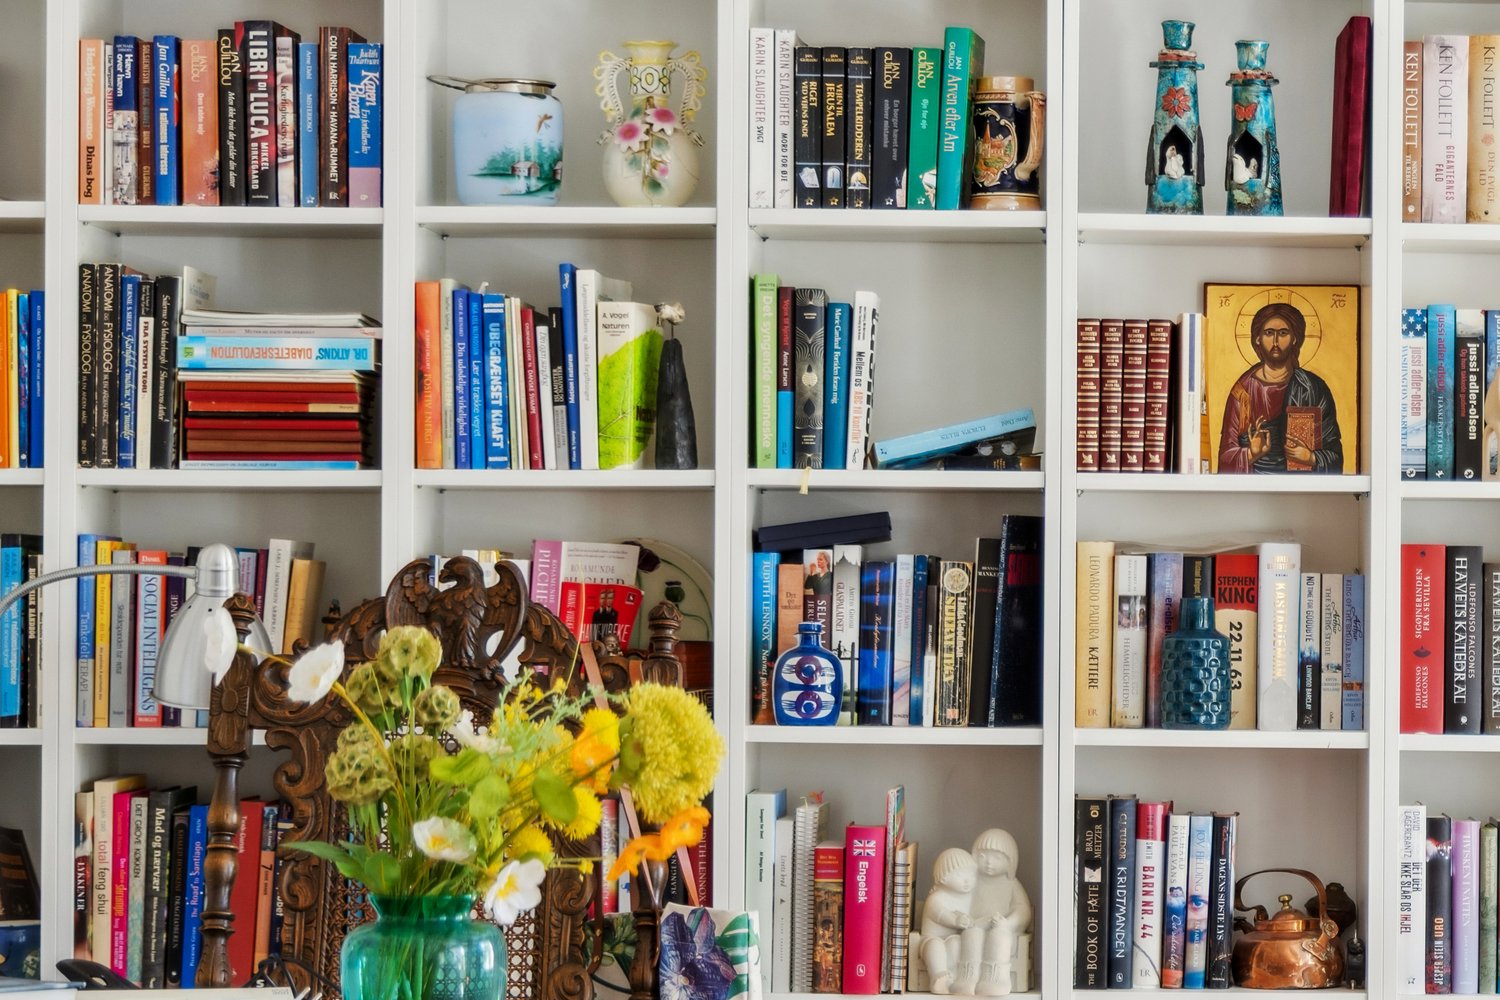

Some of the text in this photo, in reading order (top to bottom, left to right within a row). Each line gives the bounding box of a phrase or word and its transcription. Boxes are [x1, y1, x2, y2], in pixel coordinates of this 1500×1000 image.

[780, 40, 789, 69] KARIN
[249, 31, 268, 138] LIBRI DI LUCA
[329, 36, 338, 182] COLIN HARRISON HAVANA-RUMMET
[780, 73, 790, 126] SLAUGHTER
[855, 84, 864, 160] TEMPELRIDDEREN
[251, 143, 259, 189] BIRKEGAARD
[261, 142, 269, 170] MIKKEL
[211, 347, 312, 359] DIABETESREVOLUTION
[473, 360, 482, 375] Lær
[760, 296, 773, 447] Det syngende menneske
[473, 388, 482, 413] trække
[490, 324, 503, 448] UBEGRÆNSET KRAFT
[472, 416, 482, 437] vejret
[762, 560, 770, 597] JUDITH
[1217, 577, 1255, 586] STEPHEN
[1218, 588, 1255, 603] KING
[761, 601, 770, 640] LENNOX
[836, 582, 844, 632] GLASPALADSET
[1088, 555, 1099, 690] LEONARDO PADURA KÆTTERE
[1454, 558, 1466, 703] HAVETS KATEDRAL
[141, 576, 157, 711] SOCIAL INTELLIGENS
[760, 650, 769, 674] Navnet
[1230, 621, 1242, 690] 22.11.63
[760, 677, 767, 686] på
[152, 808, 165, 891] Mad og nærvær
[96, 841, 108, 915] total feng shui
[857, 861, 868, 903] Engelsk
[1116, 830, 1127, 957] TUDOR KRIDTMANDEN
[1141, 866, 1155, 938] BARN NR. 44
